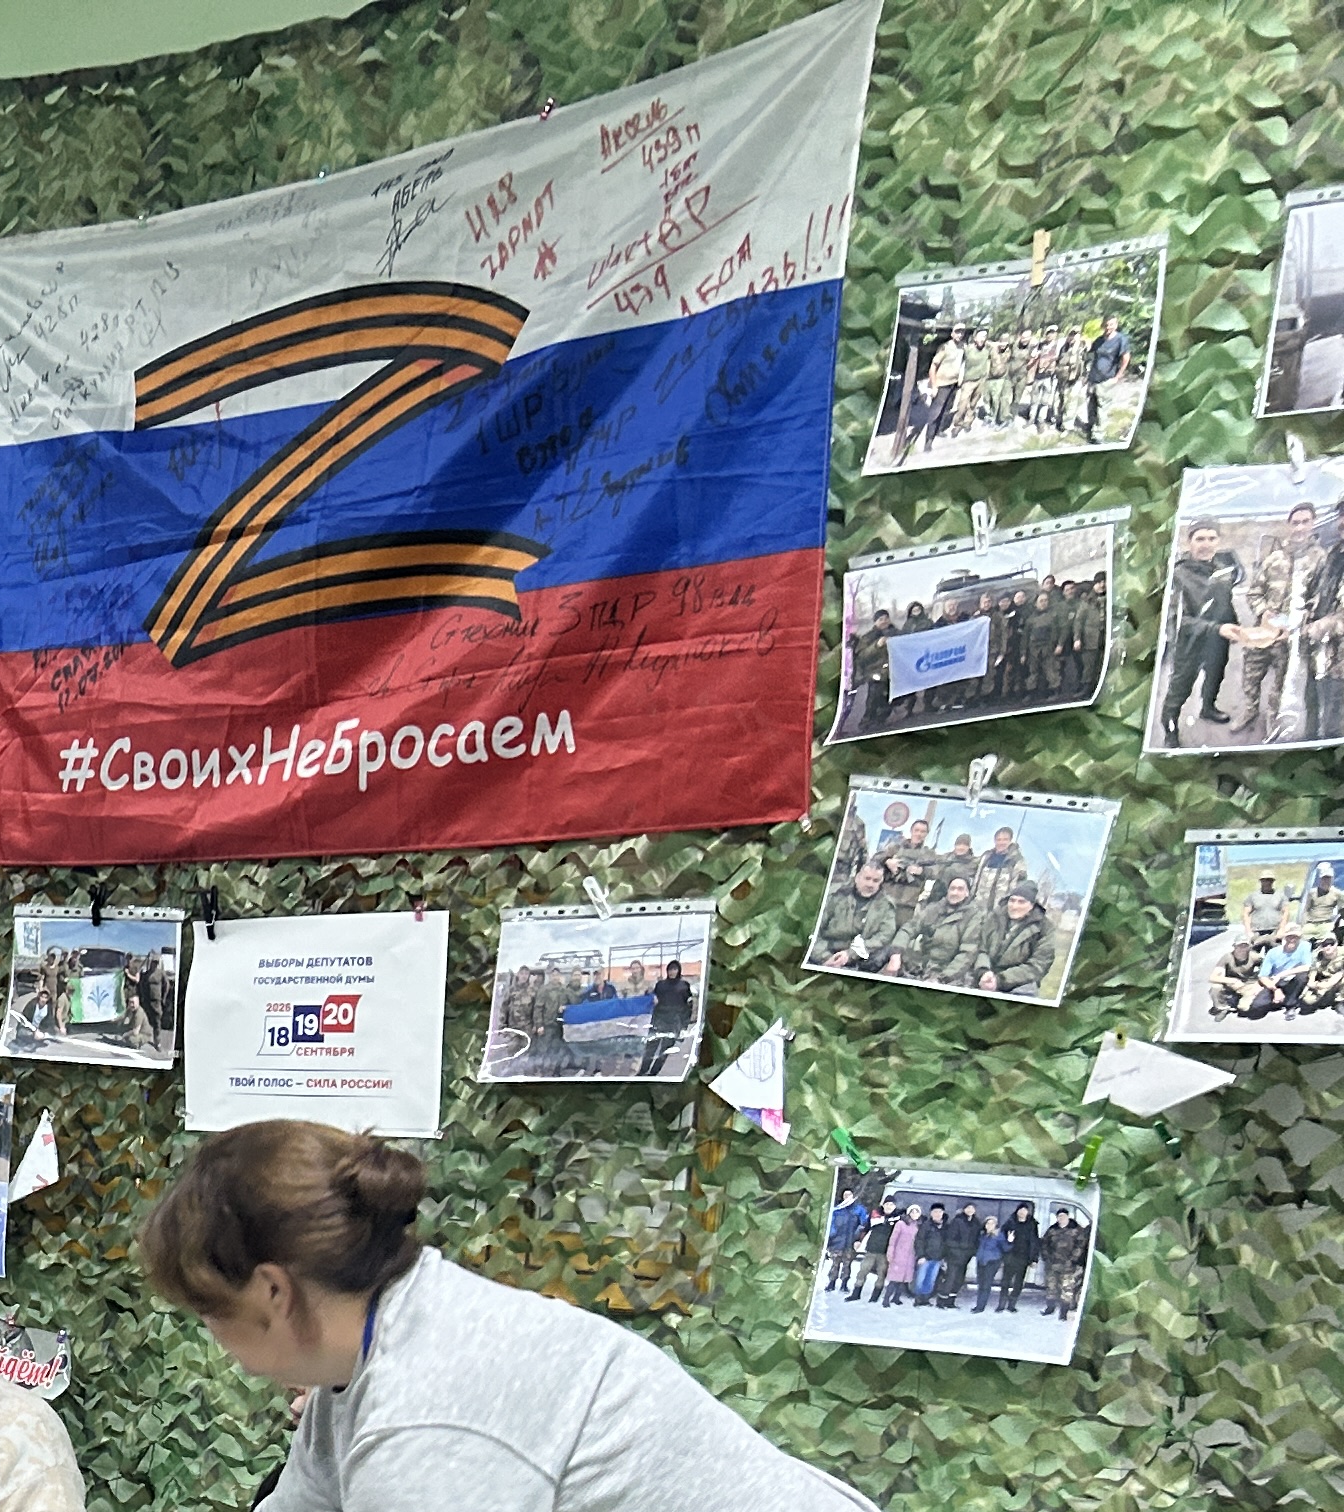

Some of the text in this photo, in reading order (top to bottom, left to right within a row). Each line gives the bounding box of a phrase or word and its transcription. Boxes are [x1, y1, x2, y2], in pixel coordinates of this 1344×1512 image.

[58, 709, 576, 793] #СвоихНеБросаем
[258, 956, 373, 969] ВЫБОРЫ ДЕПУТАТОВ
[253, 974, 375, 985] ГОСУДАРСТВЕННОЙ ДУМЫ
[266, 1003, 291, 1013] 2026
[267, 1002, 354, 1047] 18 19 20
[296, 1047, 355, 1057] СЕНТЯБРЯ
[229, 1075, 256, 1088] ТВОЙ
[258, 1078, 293, 1088] ГОЛОС
[306, 1078, 337, 1089] СИЛА
[340, 1079, 393, 1090] РОССИИ!
